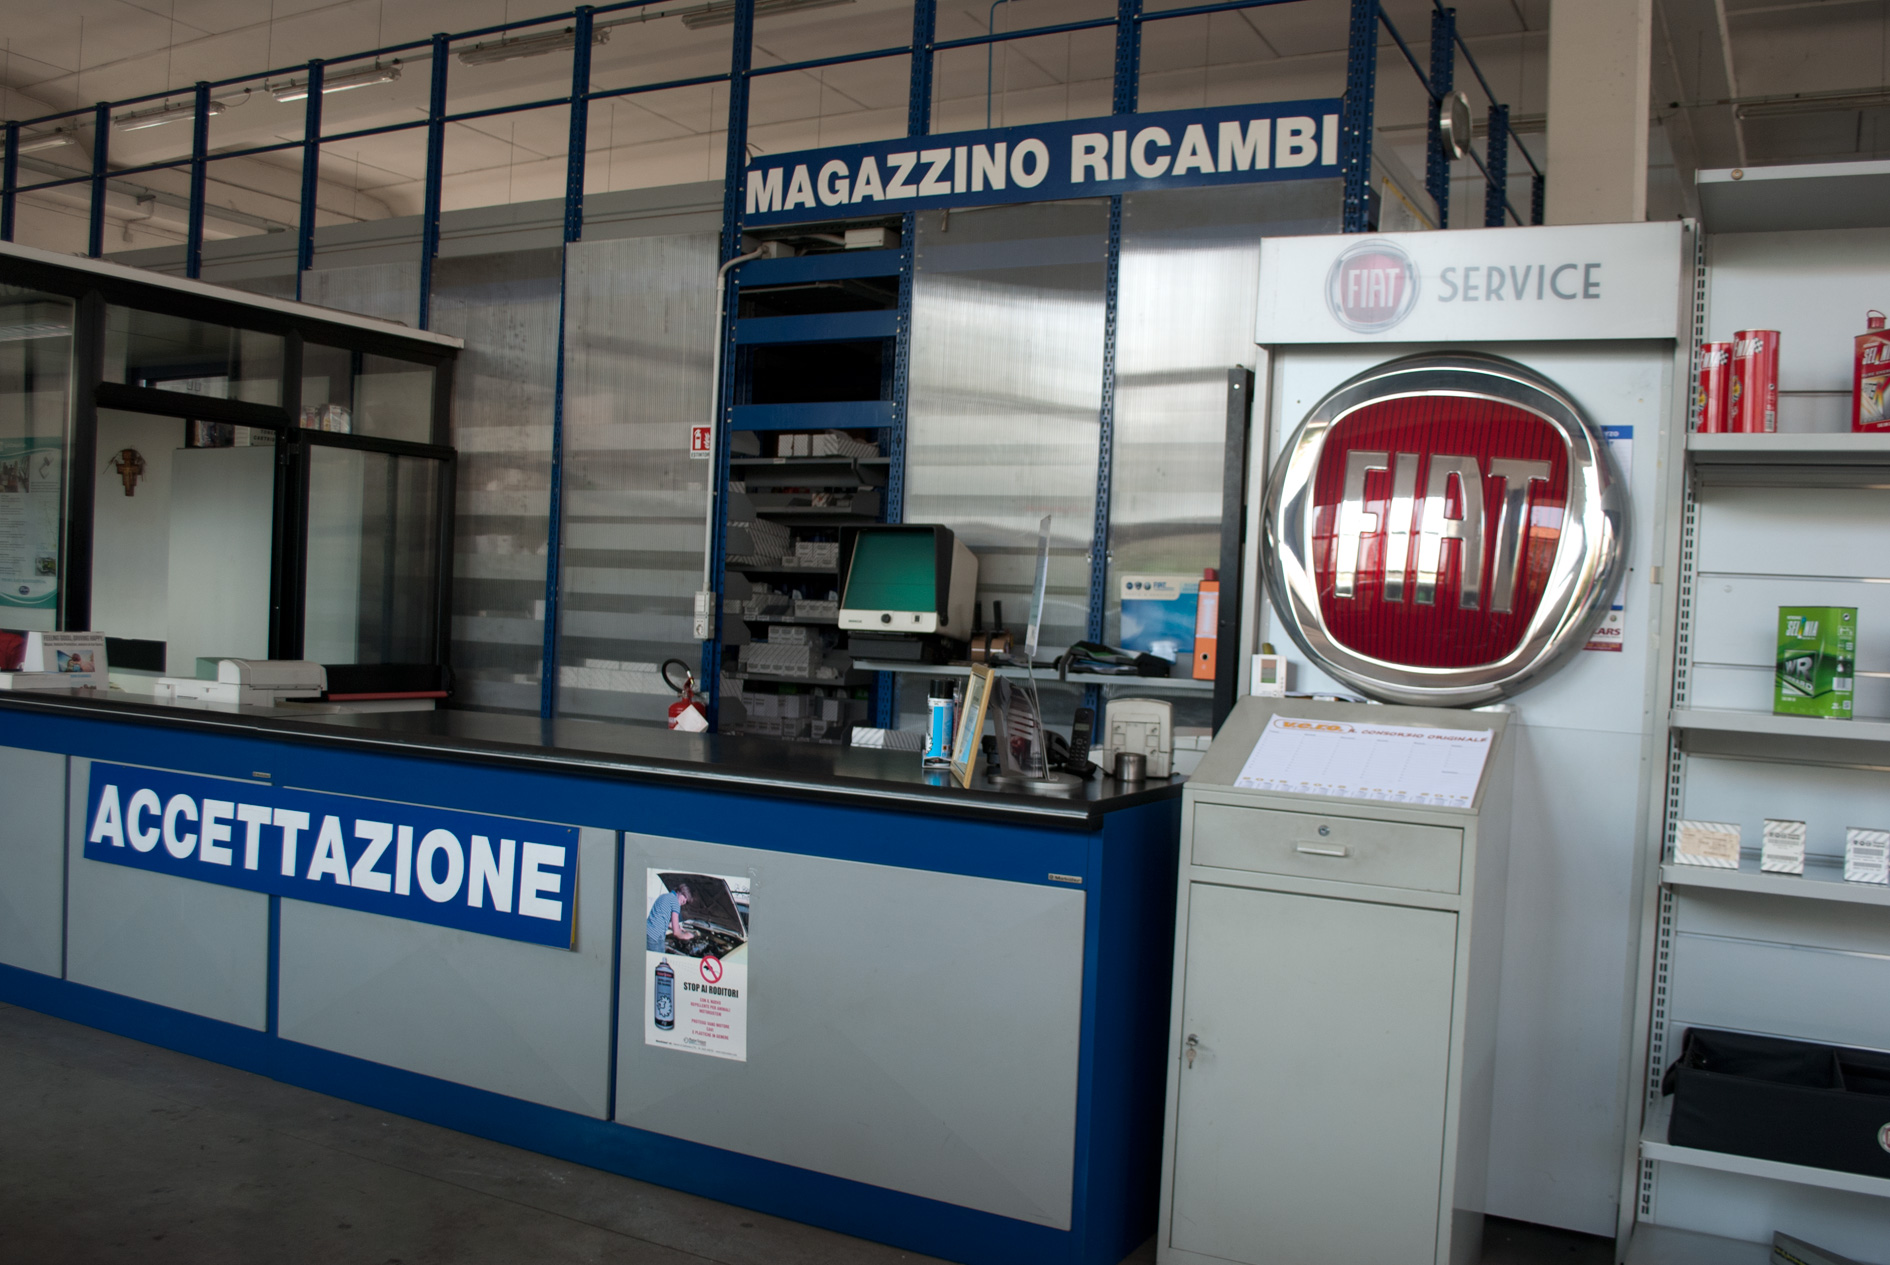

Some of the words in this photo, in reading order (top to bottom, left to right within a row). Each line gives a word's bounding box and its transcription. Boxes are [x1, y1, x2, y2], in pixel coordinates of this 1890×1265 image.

[745, 138, 1050, 215] MAGAZZINO
[1070, 114, 1339, 184] RICAMBI
[1346, 267, 1401, 309] FIAT
[1438, 262, 1603, 302] SERVICE
[1334, 450, 1551, 613] FIAT
[1593, 627, 1621, 636] ARS
[1785, 656, 1813, 682] WR
[1361, 729, 1424, 738] CONSORZIO
[1427, 734, 1488, 743] ORIGINALE
[90, 784, 566, 922] ACCETTAZIONE
[683, 982, 700, 992] STOP
[701, 984, 708, 994] AI
[709, 986, 739, 998] RODITORI
